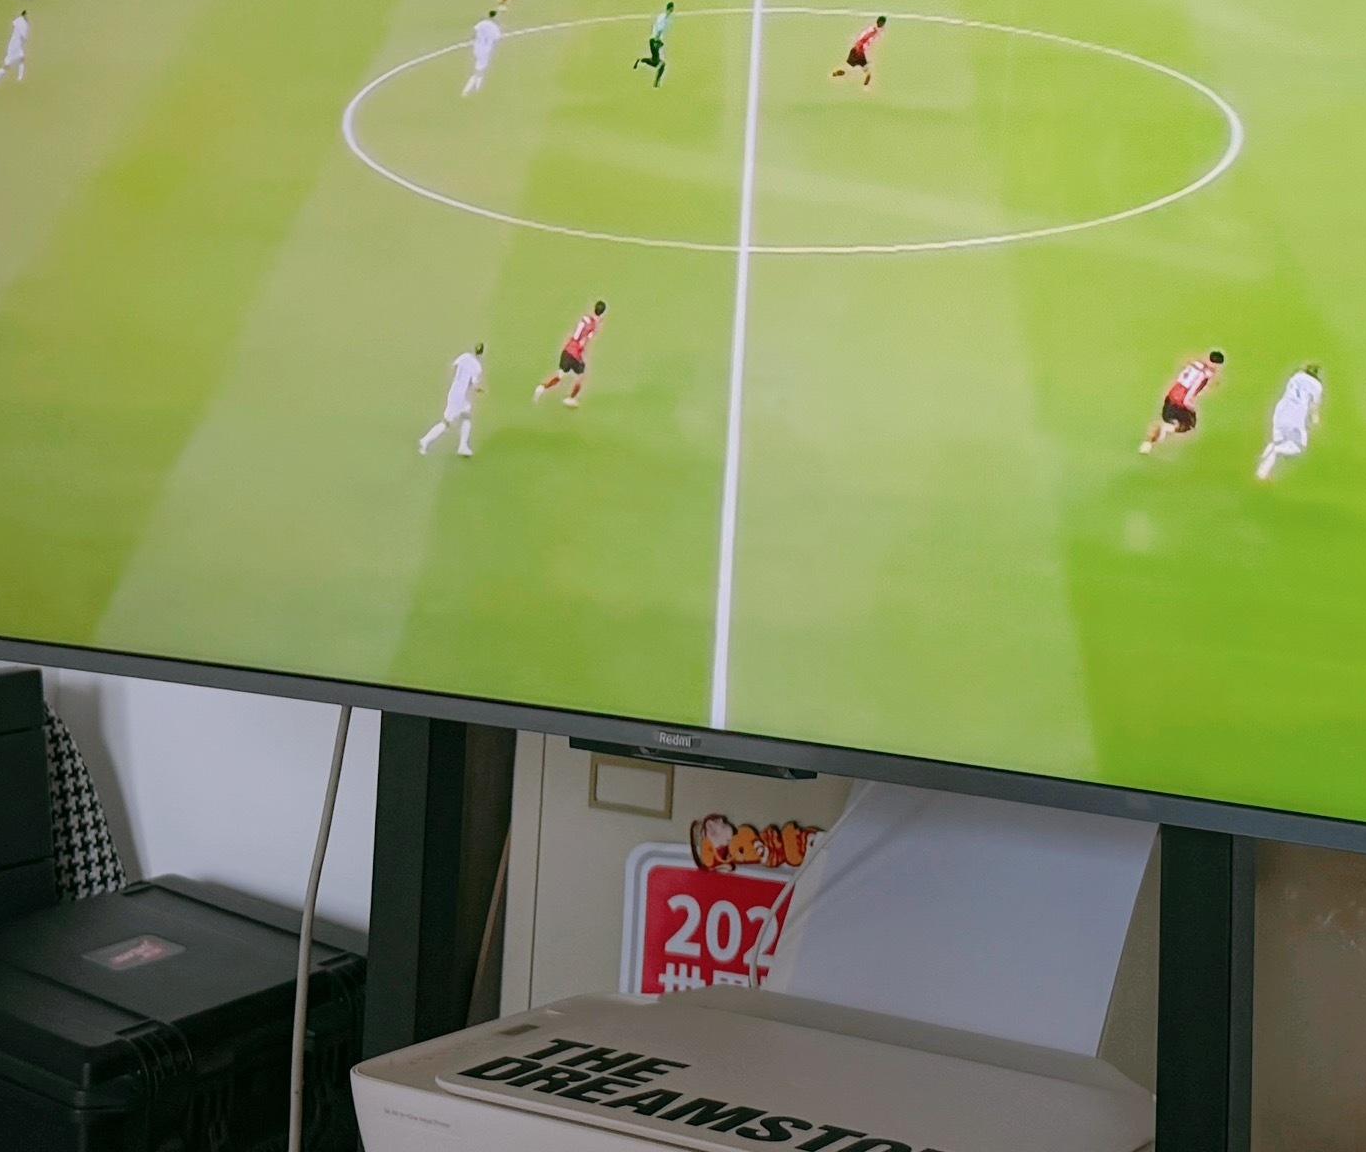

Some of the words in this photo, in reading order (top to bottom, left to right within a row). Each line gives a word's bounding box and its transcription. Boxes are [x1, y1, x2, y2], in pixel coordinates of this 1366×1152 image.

[659, 731, 692, 748] Redmi
[524, 1038, 691, 1083] THE
[456, 1056, 947, 1152] DREAMSTO
